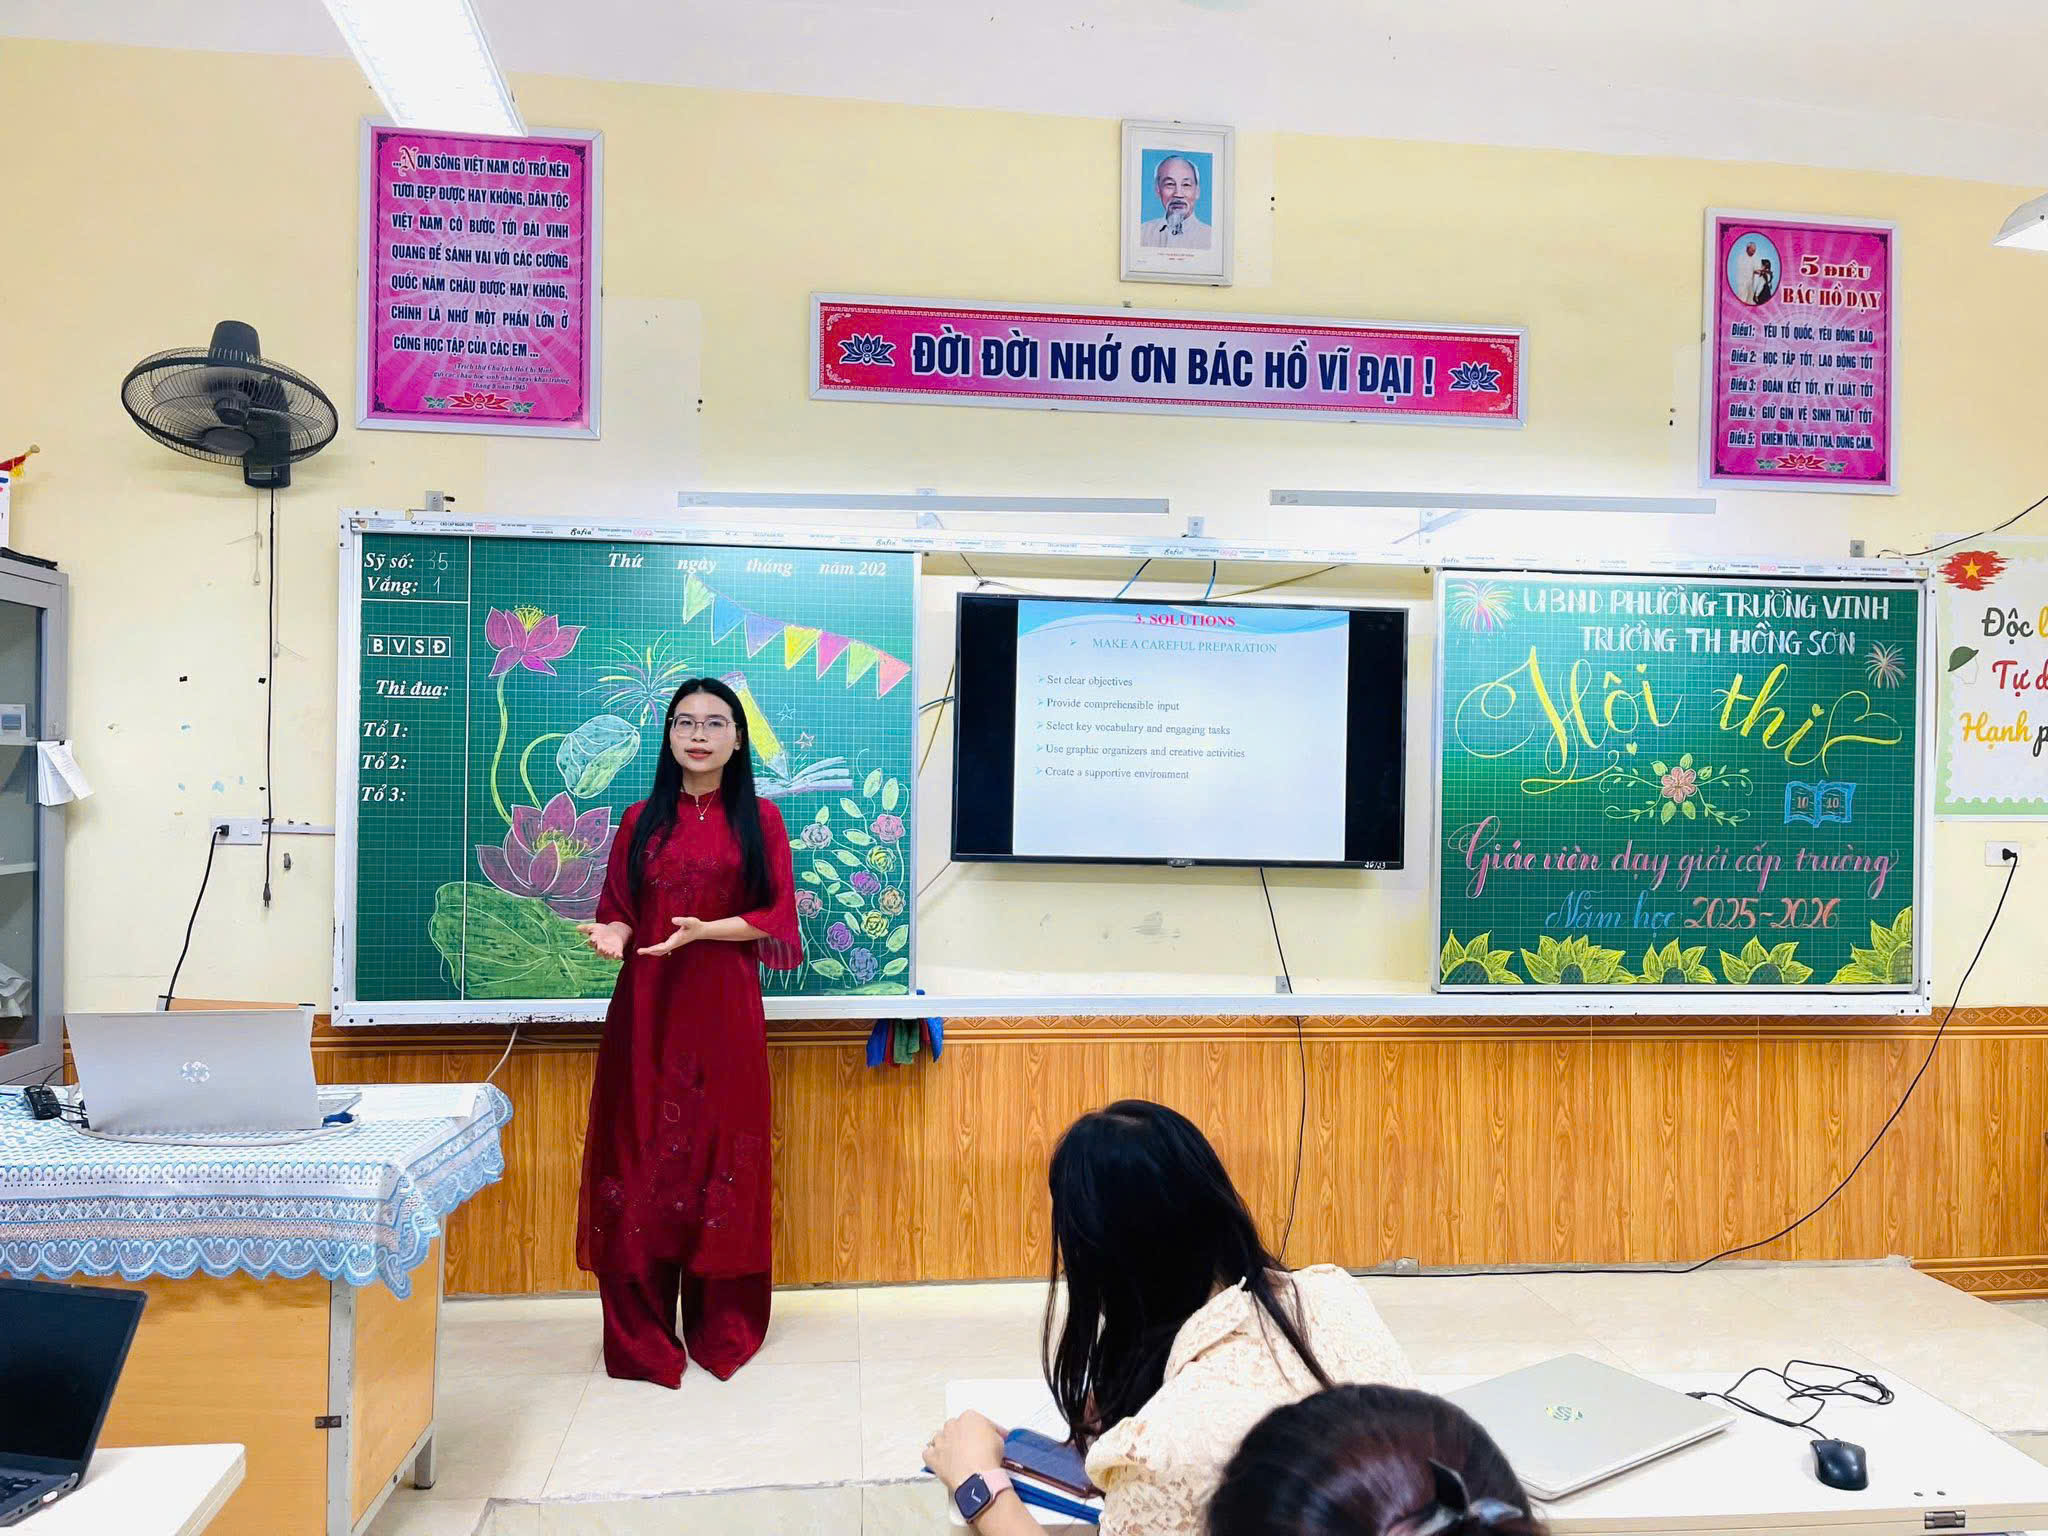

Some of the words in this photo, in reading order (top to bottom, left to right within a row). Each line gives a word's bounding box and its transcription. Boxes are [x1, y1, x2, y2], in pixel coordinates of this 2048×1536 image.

[434, 152, 460, 170] SÔNG
[464, 156, 483, 174] VIỆT
[487, 159, 509, 174] NAM
[512, 157, 525, 174] CÓ
[528, 156, 547, 175] TRỞ
[550, 160, 569, 177] NÊN
[393, 183, 414, 198] TƯƠI
[417, 186, 436, 201] ĐẸP
[439, 186, 465, 204] ĐƯỢC
[468, 188, 486, 203] HAY
[490, 188, 525, 206] KHÔNG,
[528, 190, 548, 207] DÂN
[551, 191, 568, 211] TỘC
[392, 212, 412, 232] VIỆT
[420, 216, 442, 230] NAM
[450, 215, 462, 232] CÓ
[470, 216, 495, 234] BƯỚC
[502, 218, 516, 236] TỚI
[523, 222, 540, 236] ĐÀI
[546, 224, 568, 238] VINH
[392, 244, 426, 260] QUANG
[428, 242, 442, 260] ĐỂ
[445, 246, 472, 263] SÁNH
[475, 250, 490, 264] VAI
[494, 248, 510, 265] VỚI
[513, 250, 532, 267] CÁC
[536, 250, 568, 268] CƯỜNG
[1800, 256, 1819, 276] 5
[1824, 262, 1870, 279] ĐIỀU
[392, 271, 418, 290] QUỐC
[422, 274, 445, 291] NĂM
[450, 276, 476, 293] CHÂU
[480, 280, 506, 298] ĐƯỢC
[510, 283, 528, 297] HAY
[532, 282, 568, 300] KHÔNG,
[1782, 284, 1814, 305] BÁC
[1820, 282, 1846, 307] HỒ
[1847, 290, 1880, 313] DẠY
[391, 304, 422, 320] CHÍNH
[428, 306, 440, 322] LÀ
[448, 308, 468, 323] NHỜ
[475, 309, 496, 328] MỘT
[536, 310, 554, 328] LỚN
[562, 310, 568, 328] Ở
[394, 334, 420, 350] CÔNG
[424, 338, 444, 354] HỌC
[446, 338, 464, 354] TẬP
[468, 336, 488, 354] CỦA
[490, 340, 510, 356] CÁC
[512, 343, 527, 356] EM
[912, 326, 970, 375] ĐỜI
[982, 329, 1038, 378] ĐỜI
[1050, 333, 1122, 382] NHỚ
[1131, 344, 1176, 384] ƠN
[1188, 341, 1252, 387] BÁC
[1265, 340, 1308, 390] HỒ
[1318, 346, 1350, 392] VĨ
[1358, 356, 1412, 402] ĐẠI
[1424, 358, 1433, 395] !
[364, 552, 386, 572] Sỹ
[390, 552, 414, 570] số:
[608, 552, 645, 569] Thứ
[678, 558, 717, 575] ngày
[746, 558, 793, 577] tháng
[819, 560, 855, 576] năm
[858, 560, 888, 576] 202
[367, 576, 418, 596] Vắng:
[432, 576, 440, 594] 1
[1524, 586, 1602, 617] UBND
[1610, 586, 1715, 618] PHƯỜNG
[1720, 587, 1817, 620] TRƯỜNG
[1822, 594, 1890, 620] VINH
[1135, 613, 1145, 625] 3.
[1149, 614, 1236, 628] SOLUTIONS
[1982, 606, 2034, 645] Độc
[1092, 638, 1129, 650] MAKE
[1130, 640, 1140, 650] A
[1141, 640, 1196, 652] CAREFUL
[1198, 641, 1278, 654] PREPARATION
[1582, 620, 1676, 653] TRƯỜNG
[1685, 628, 1722, 654] TH
[1730, 621, 1802, 656] HỒNG
[1808, 626, 1856, 656] SƠN
[376, 680, 406, 697] Thi
[410, 680, 448, 697] đua:
[1047, 674, 1062, 685] Set
[1064, 676, 1086, 686] clear
[1088, 676, 1133, 688] objectives
[1992, 660, 2030, 698] Tự
[1046, 698, 1082, 708] Provide
[1084, 698, 1154, 712] comprehensible
[1157, 701, 1180, 713] input
[362, 720, 389, 738] Tổ
[391, 722, 408, 738] 1:
[1046, 720, 1074, 732] Select
[1076, 721, 1092, 734] key
[1095, 722, 1144, 735] vocabulary
[1146, 724, 1163, 734] and
[1166, 725, 1206, 737] engaging
[1208, 724, 1231, 736] tasks
[1712, 663, 1903, 775] thi
[1960, 710, 2032, 750] Hạnh
[362, 752, 388, 770] Tổ
[390, 754, 407, 770] 2:
[1046, 744, 1064, 754] Use
[1066, 744, 1099, 757] graphic
[1102, 746, 1148, 758] organizers
[1150, 746, 1166, 756] and
[1169, 747, 1204, 758] creative
[1206, 748, 1246, 758] activities
[1045, 767, 1074, 777] Create
[1077, 770, 1082, 778] a
[1084, 768, 1132, 780] supportive
[1134, 768, 1190, 780] environment
[362, 784, 388, 802] Tổ
[390, 787, 406, 802] 3:
[1448, 816, 1537, 899] Giáo
[1544, 844, 1602, 872] viên
[1611, 839, 1670, 891] dạy
[1676, 844, 1731, 892] giỏi
[1734, 840, 1782, 893] cấp
[1796, 844, 1899, 900] trường
[1545, 890, 1622, 929] Năm
[1632, 890, 1677, 938] học
[1684, 896, 1840, 930] 2025-2026
